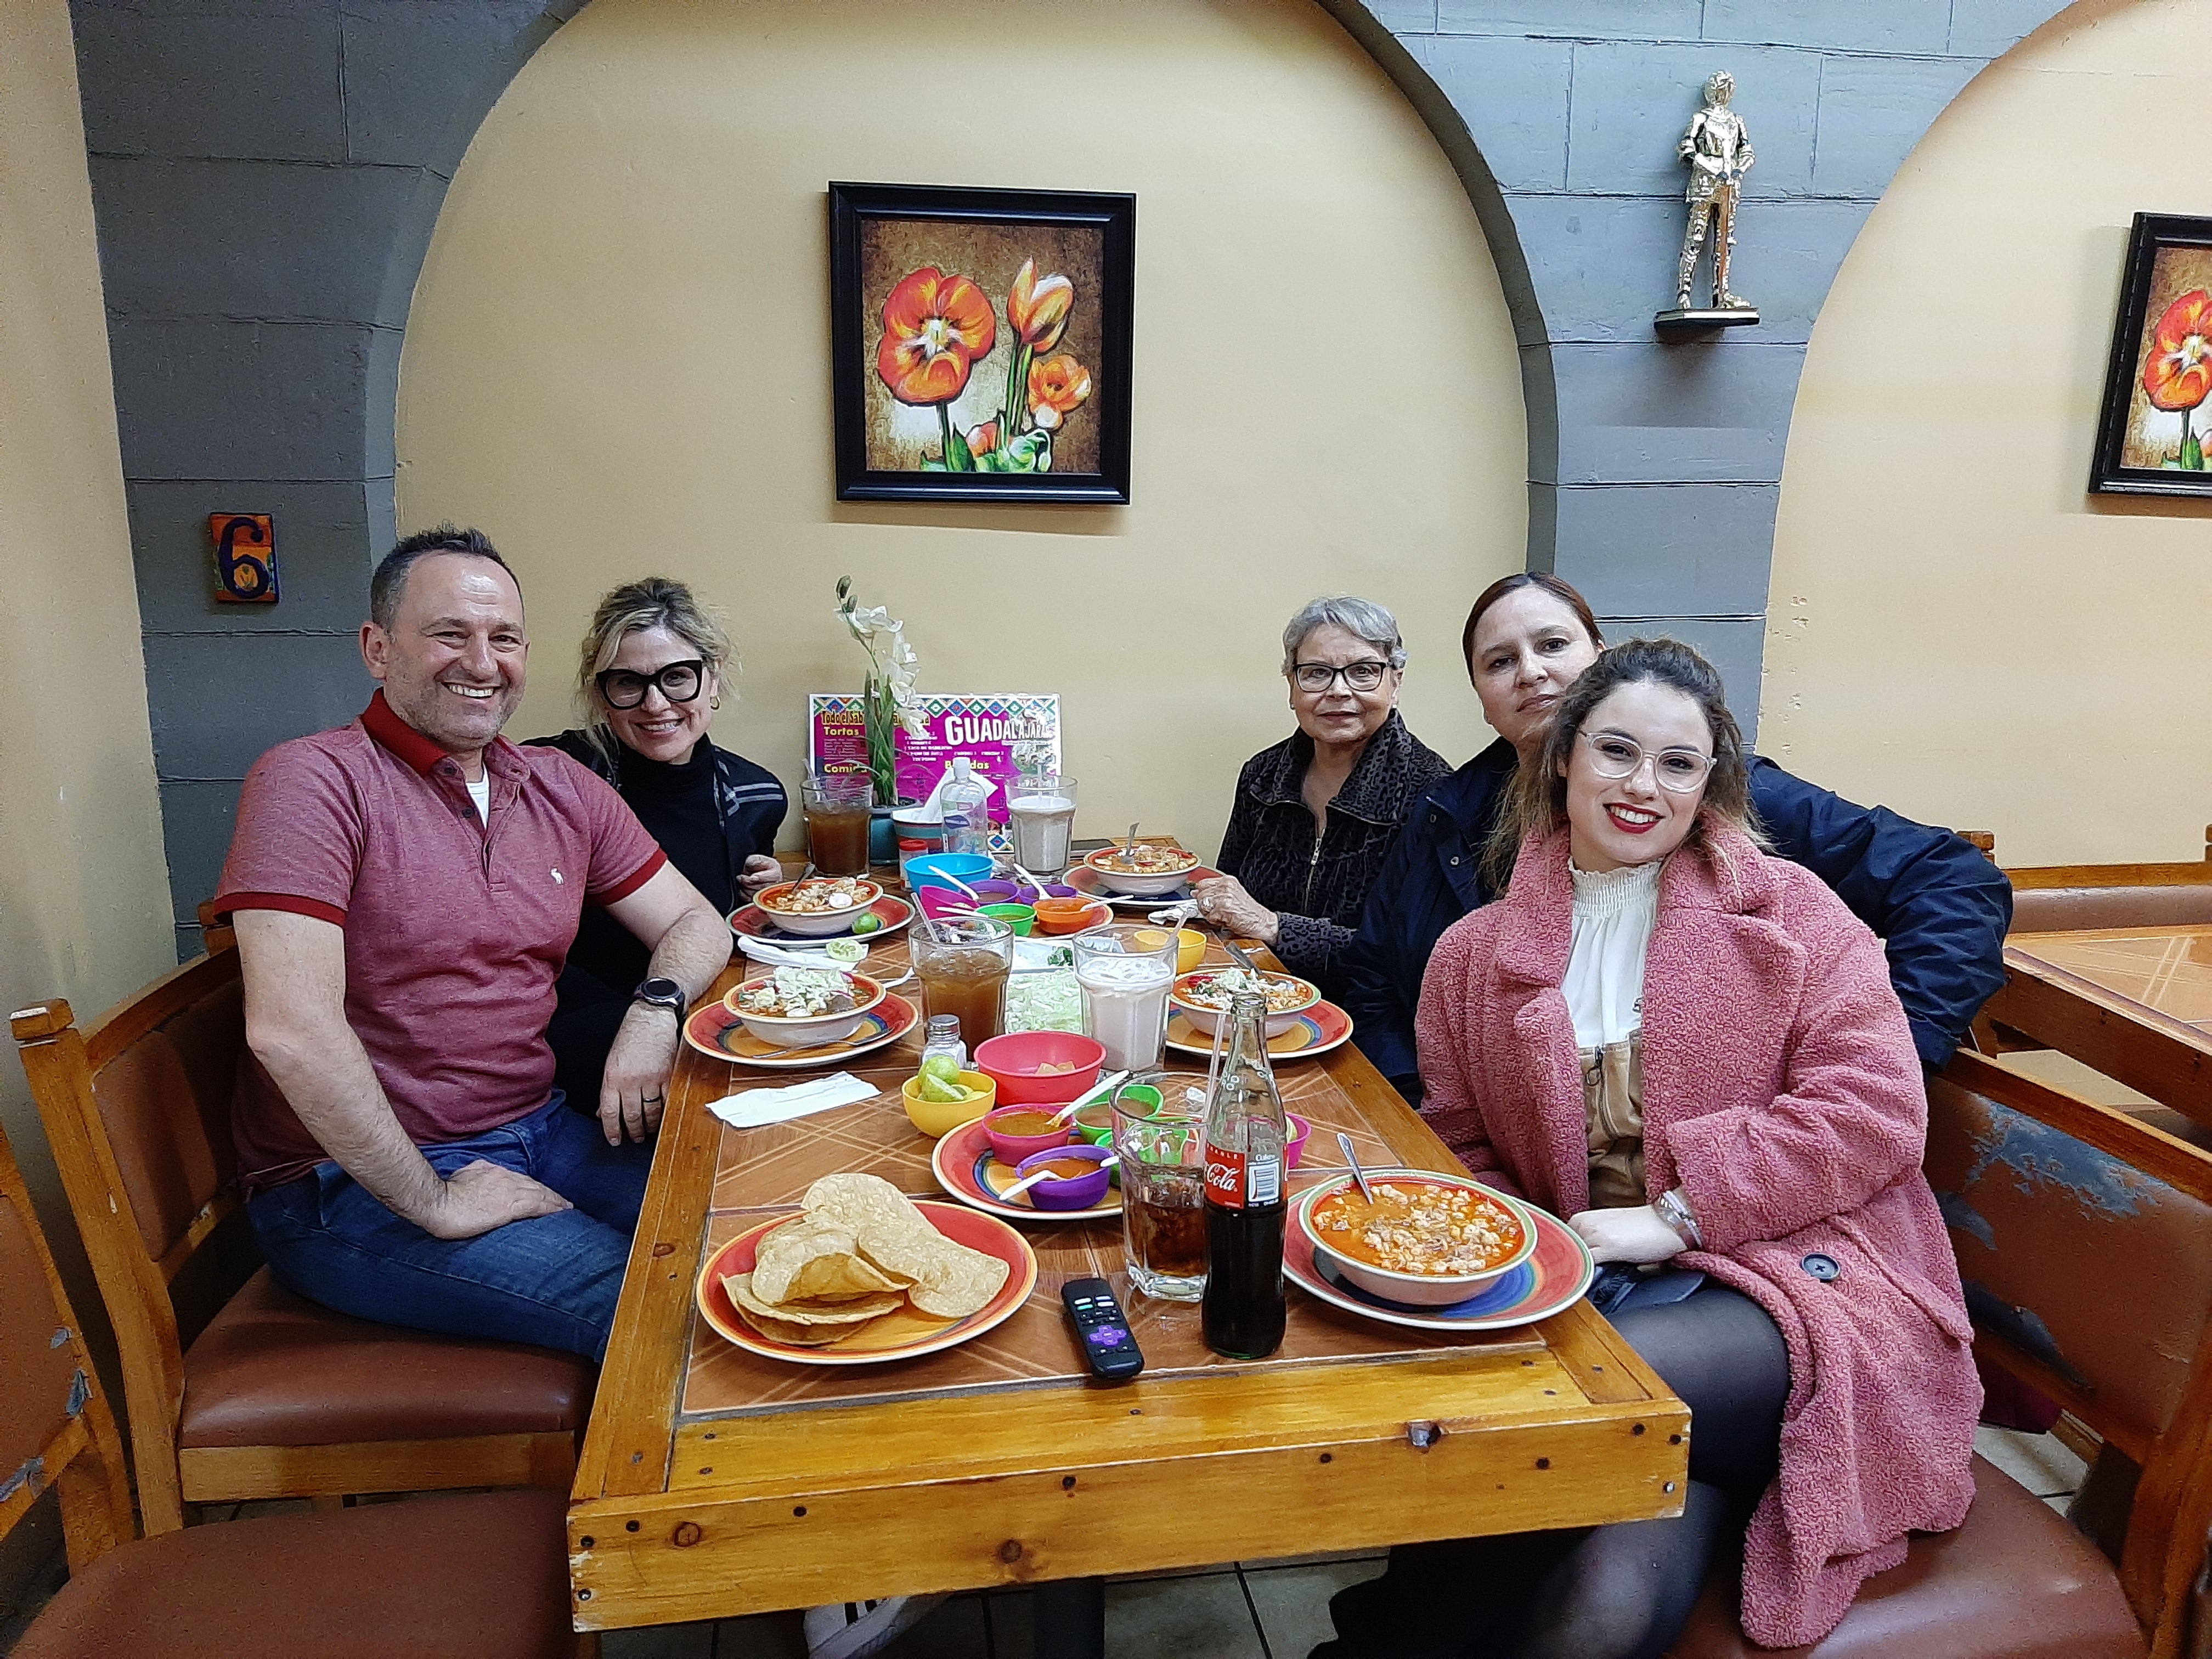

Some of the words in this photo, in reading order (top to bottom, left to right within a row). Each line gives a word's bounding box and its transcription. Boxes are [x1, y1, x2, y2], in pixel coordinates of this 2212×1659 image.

[218, 517, 269, 599] 6
[822, 710, 840, 725] Todo
[841, 711, 849, 725] el
[849, 710, 865, 725] Sab
[823, 726, 860, 736] Tortas
[945, 715, 1047, 746] GUADALAJARA
[824, 763, 867, 773] Comi
[945, 760, 990, 770] Bdas
